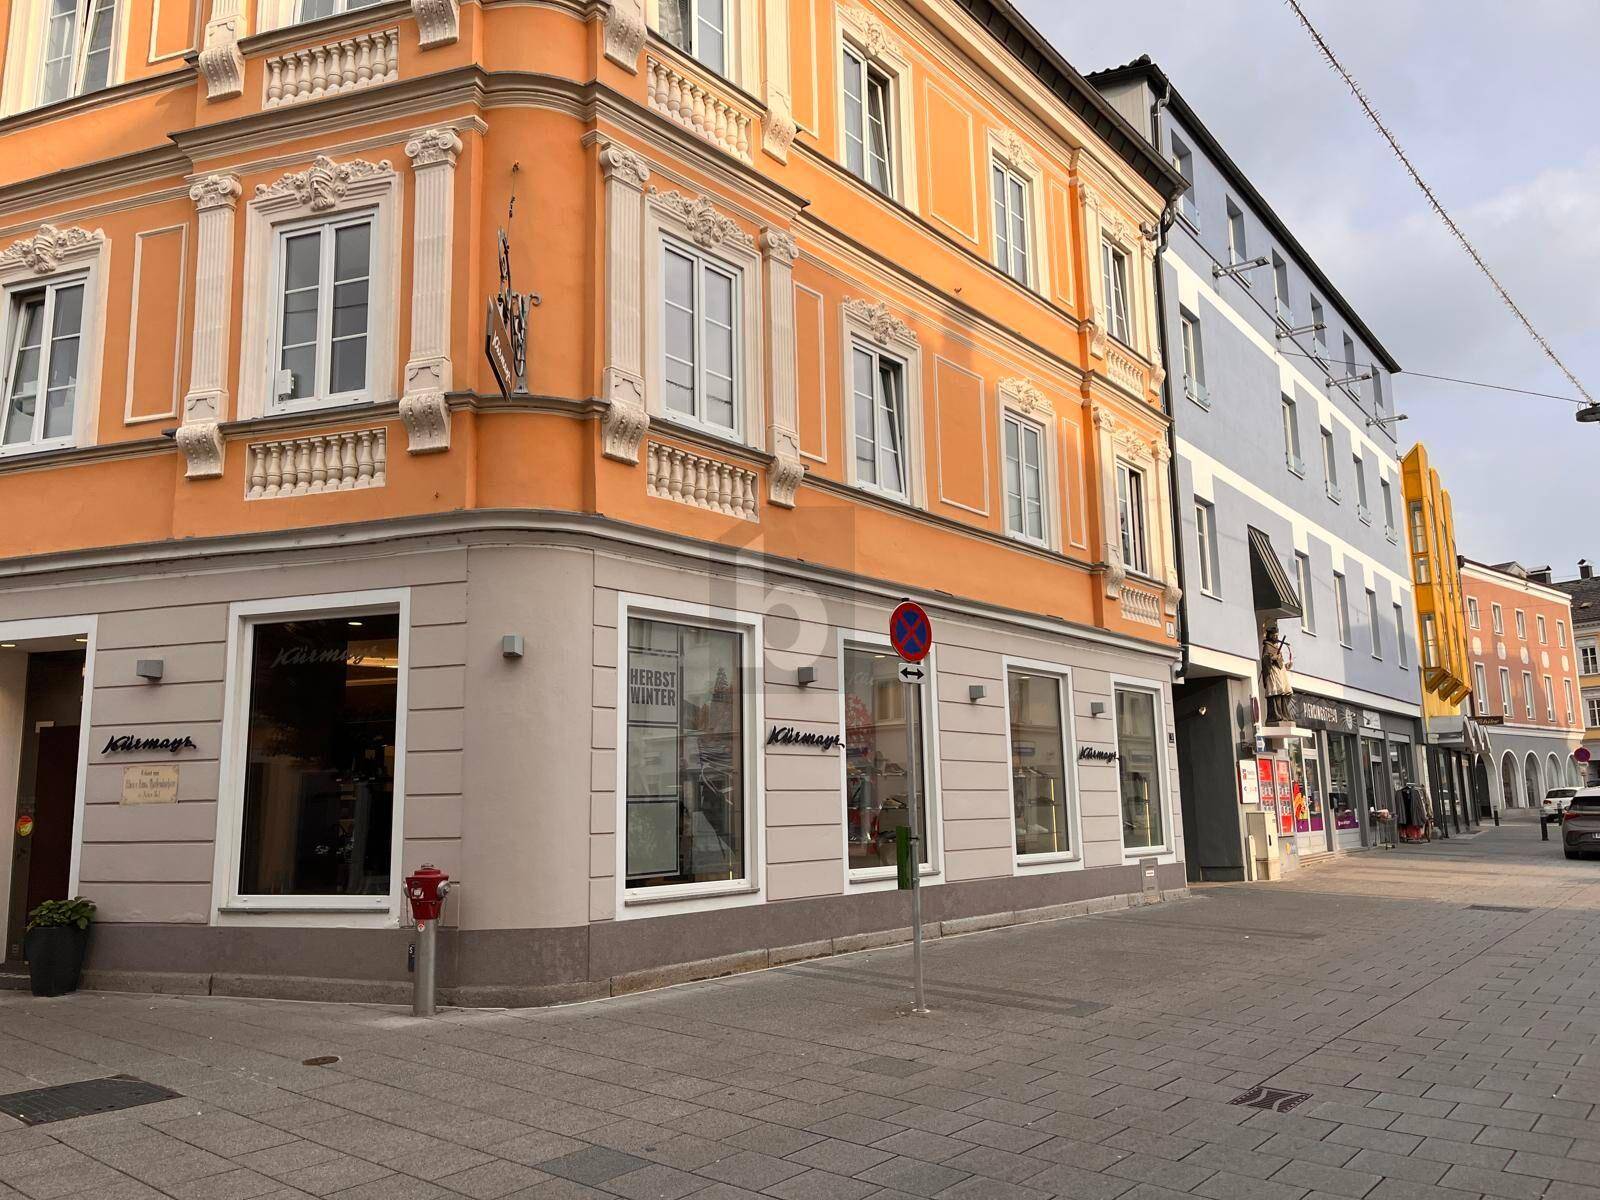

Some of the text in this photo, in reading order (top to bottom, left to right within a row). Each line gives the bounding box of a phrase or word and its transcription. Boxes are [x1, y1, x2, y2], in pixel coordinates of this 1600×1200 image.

[630, 668, 676, 688] HERBST
[630, 686, 676, 706] WINTER
[101, 734, 197, 754] Kürmayr
[766, 725, 845, 750] Kürmayr
